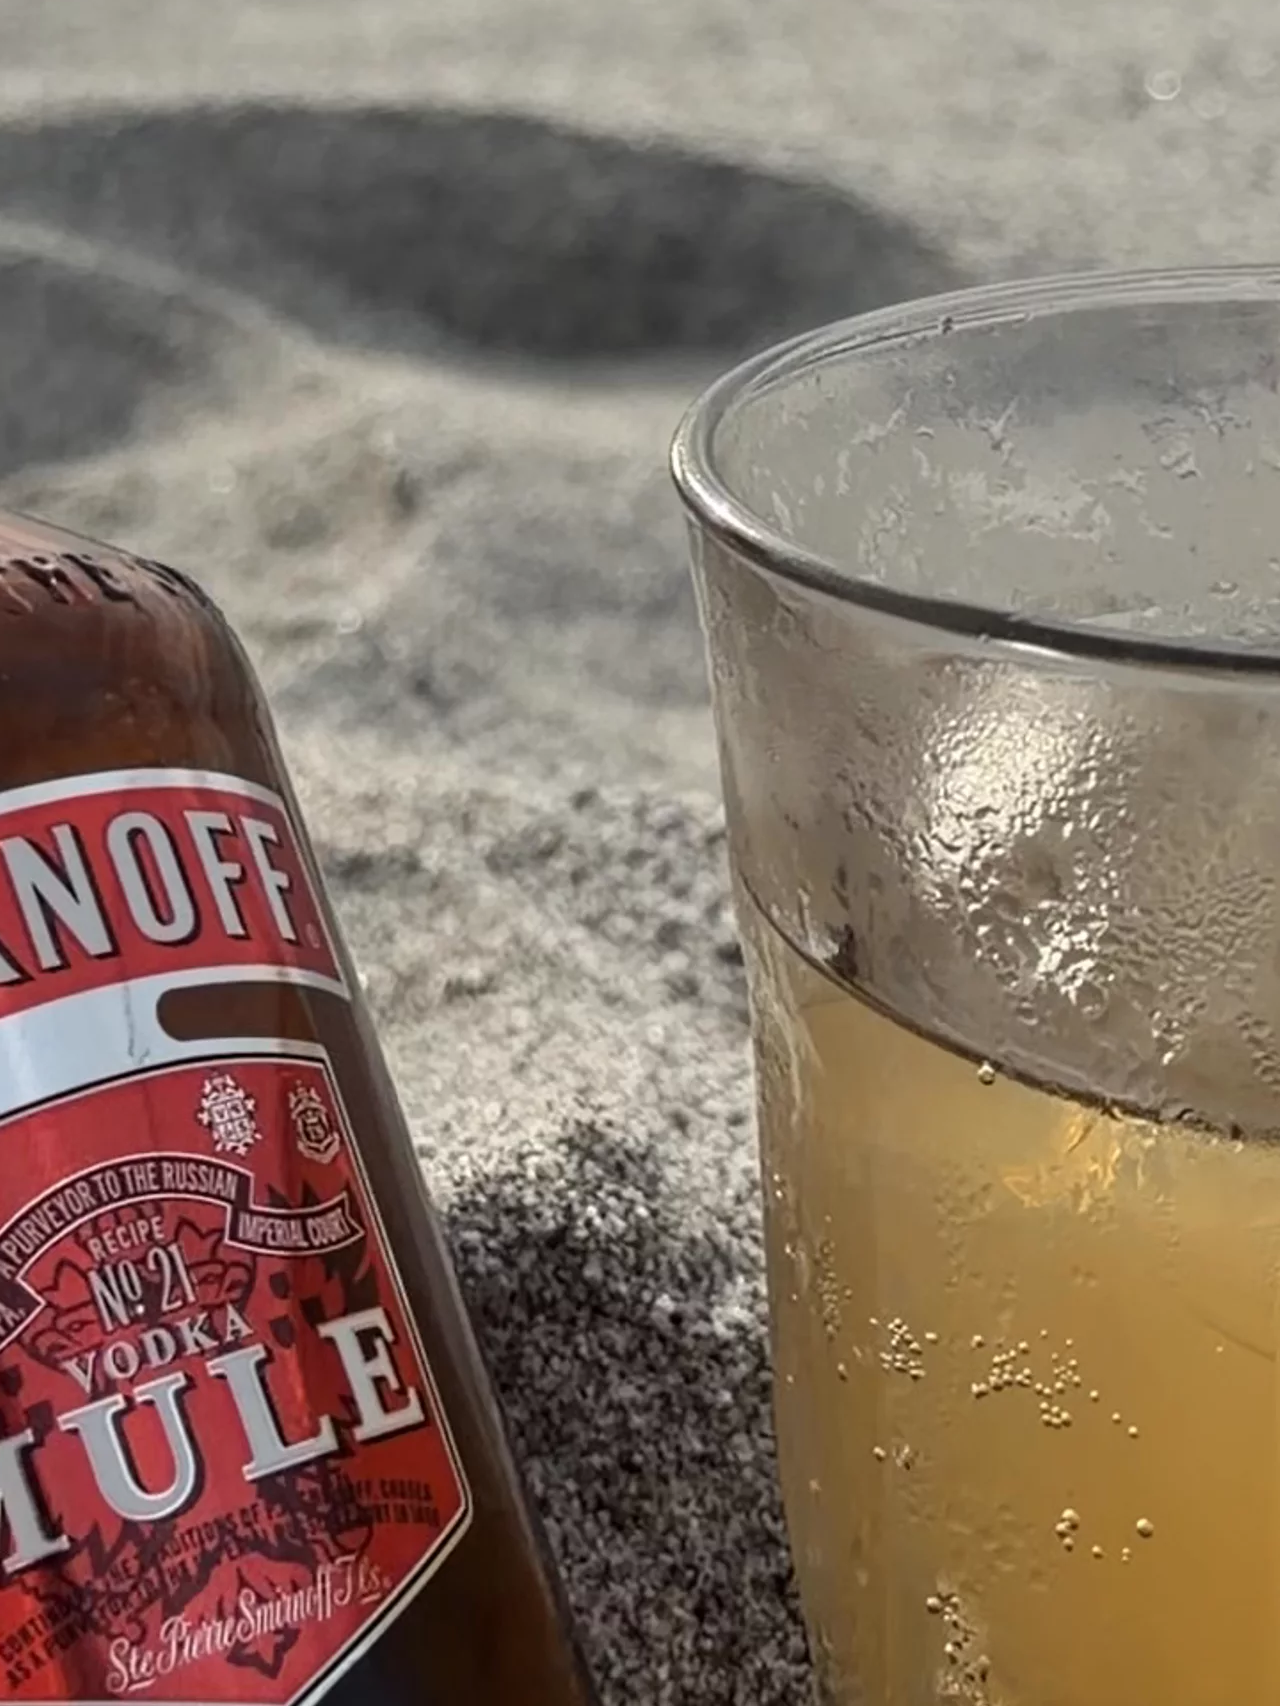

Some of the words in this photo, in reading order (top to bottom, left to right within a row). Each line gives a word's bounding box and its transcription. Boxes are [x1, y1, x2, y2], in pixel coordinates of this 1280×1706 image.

[4, 1182, 91, 1267] PURVEYOR
[91, 1170, 120, 1203] TO
[120, 1163, 160, 1195] THE
[161, 1160, 239, 1200] RUSSIAN
[88, 1215, 166, 1262] RECIPE
[238, 1211, 308, 1248] IMPERIAL
[306, 1207, 351, 1245] COURT
[147, 1242, 196, 1312] 21
[61, 1304, 255, 1394] VODKA
[236, 1559, 333, 1644] Smirnoff
